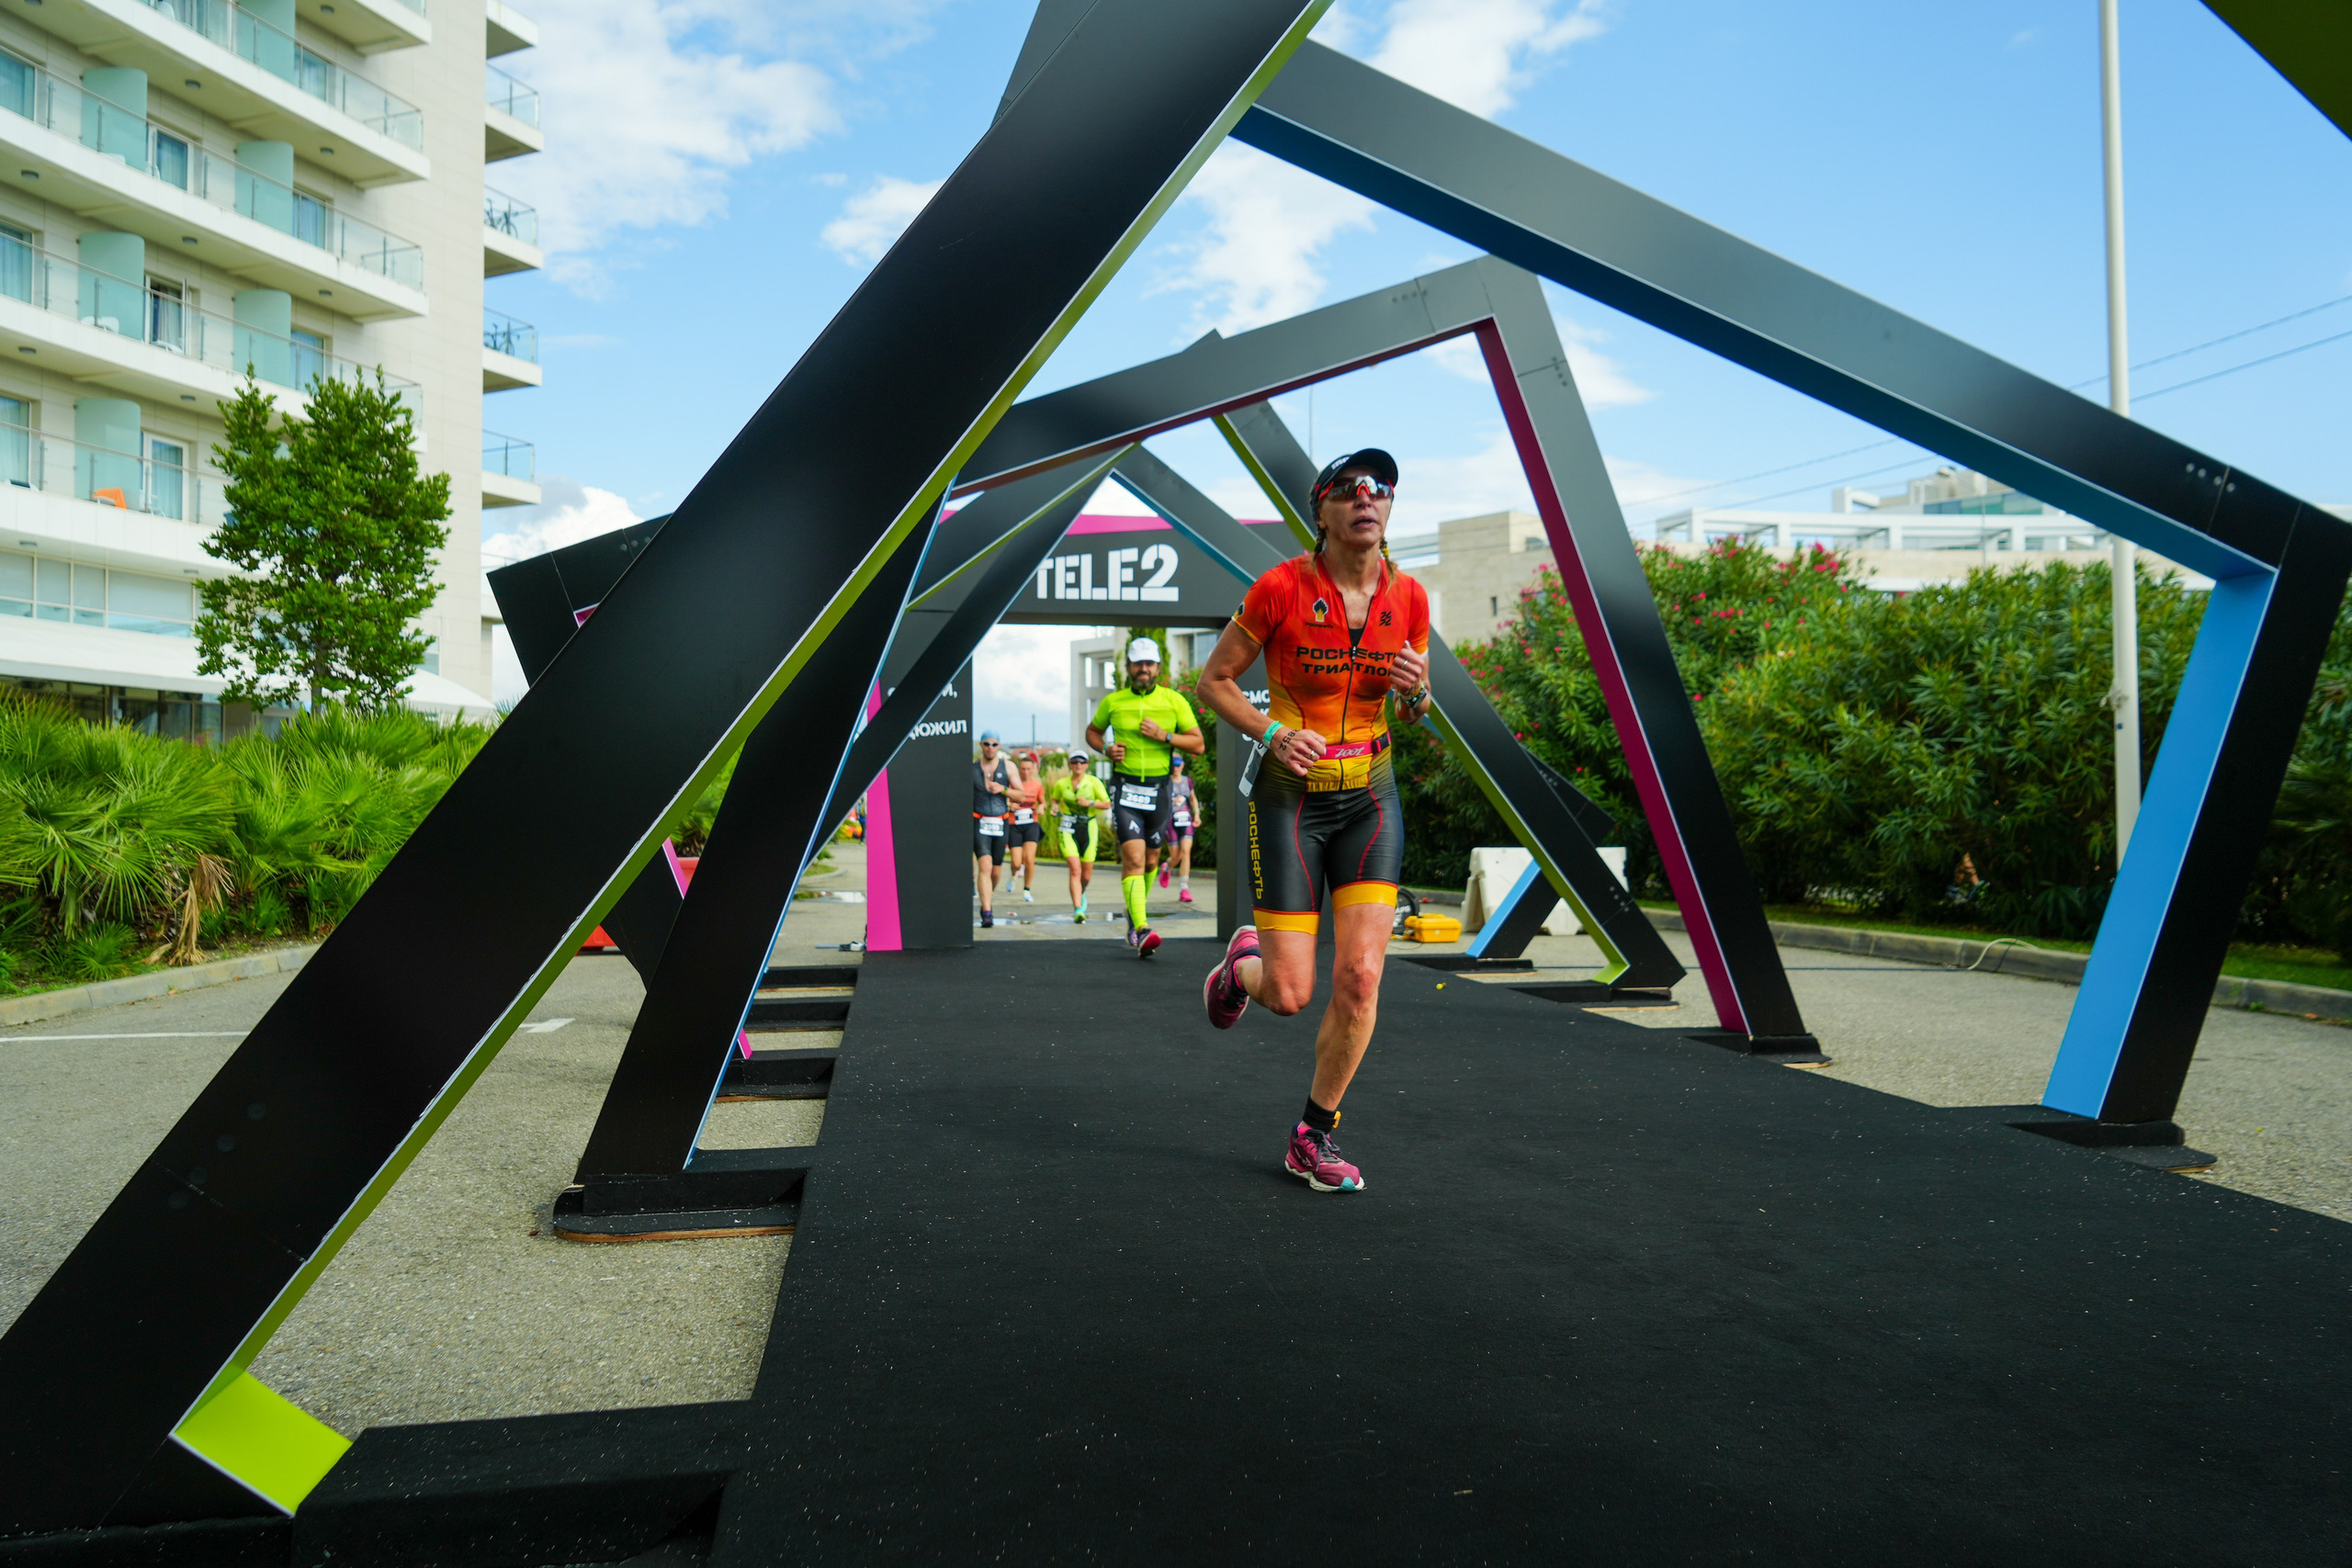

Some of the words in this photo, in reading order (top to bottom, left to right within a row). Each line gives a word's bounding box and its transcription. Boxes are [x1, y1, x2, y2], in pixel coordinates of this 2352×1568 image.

[1037, 543, 1180, 603] TELE2
[1278, 728, 1301, 750] 852
[1249, 801, 1264, 900] РОСНЕФТЬ
